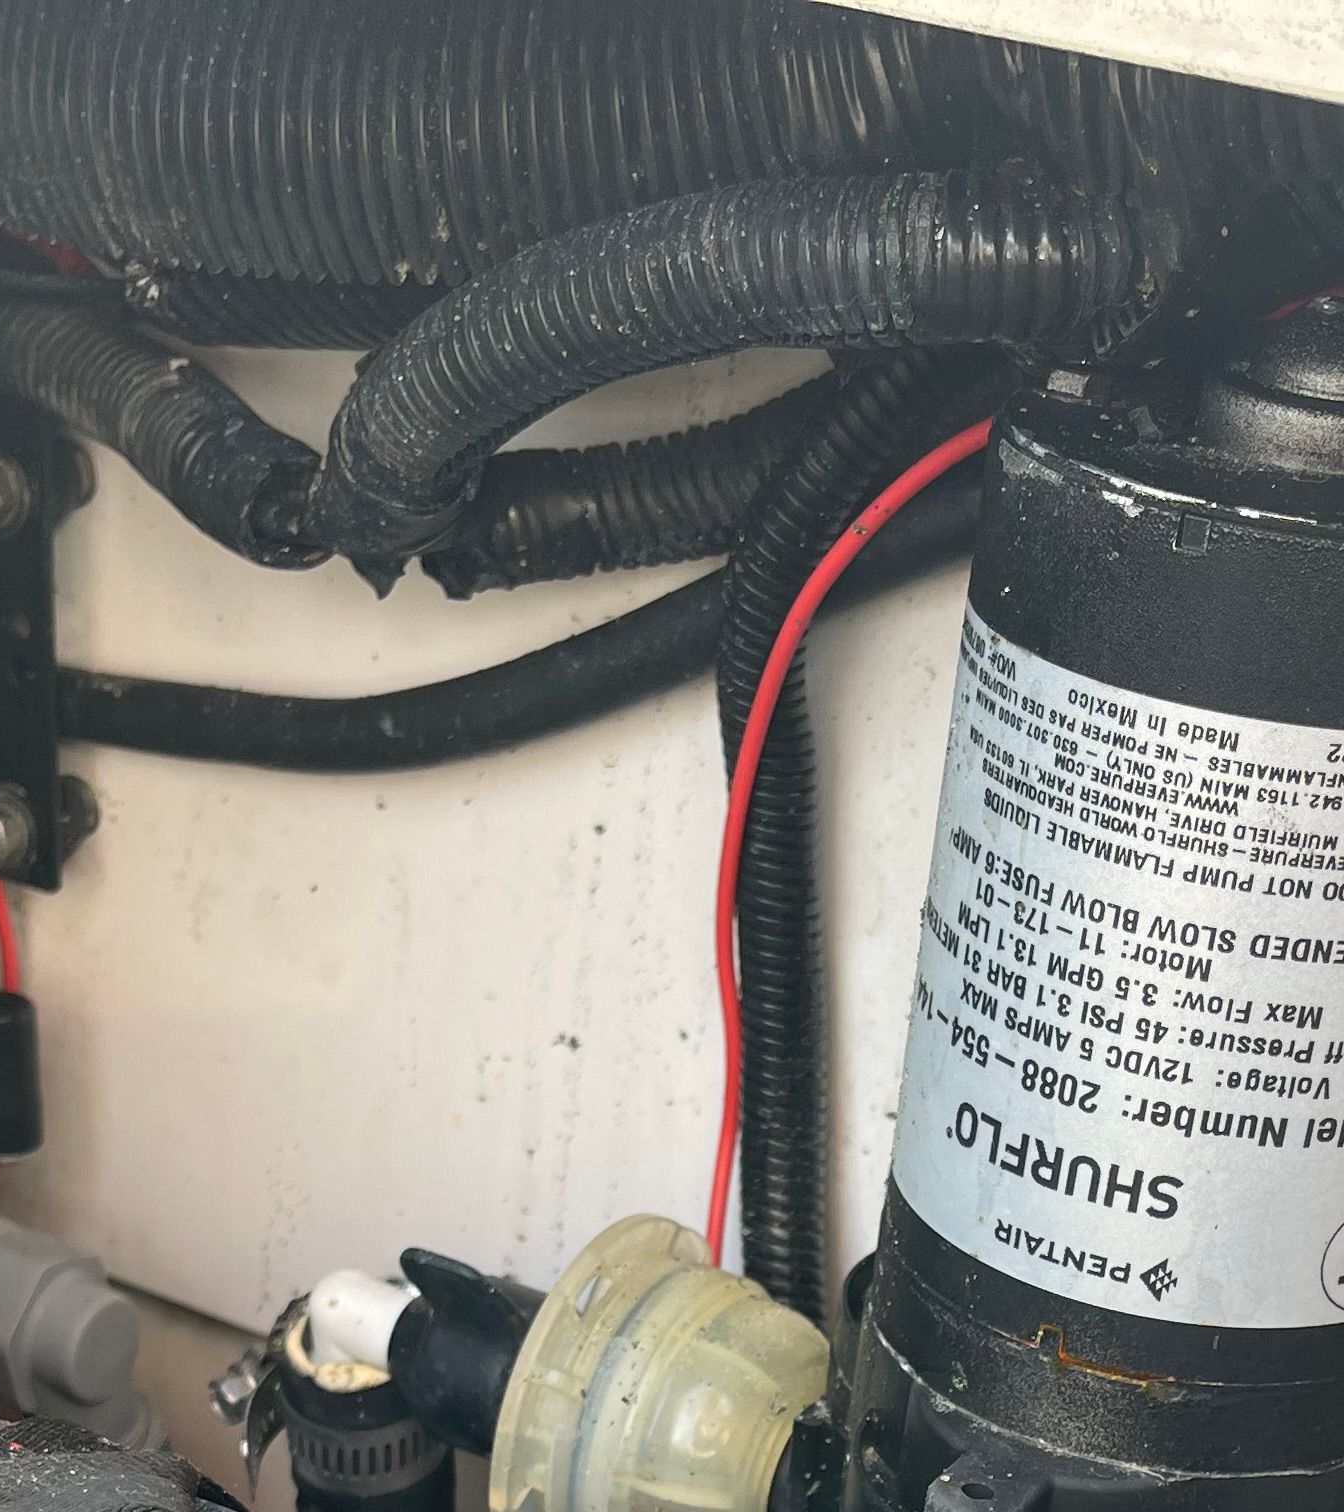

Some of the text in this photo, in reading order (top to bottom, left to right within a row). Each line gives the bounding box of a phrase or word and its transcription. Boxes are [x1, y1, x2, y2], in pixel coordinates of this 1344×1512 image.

[975, 688, 996, 715] MAIN
[1020, 696, 1045, 720] DES
[998, 706, 1079, 756] 630.307.3000
[1049, 709, 1076, 733] PAS
[1068, 689, 1239, 752] Made In Mexico
[1081, 722, 1148, 755] POMPER
[1155, 743, 1178, 763] NE
[1018, 759, 1030, 777] IL
[1034, 765, 1075, 796] PARK,
[1105, 751, 1156, 782] ONLY)
[1162, 769, 1193, 790] (US
[982, 758, 1073, 820] HEADQUARTERS
[1054, 753, 1238, 817] WWW.EVERPURE.COM
[1199, 777, 1250, 799] MAIN
[983, 787, 1039, 834] LIQUIDS
[1079, 787, 1157, 821] HANOVER
[1079, 808, 1137, 837] WORLD
[1165, 809, 1226, 837] DRIVE,
[1233, 824, 1337, 850] MUIRFIELD
[950, 826, 981, 864] AMP
[1046, 822, 1174, 879] FLAMMABLE
[1183, 865, 1254, 893] PUMP
[1262, 876, 1313, 899] NOT
[1061, 890, 1140, 934] BLOW
[1148, 916, 1236, 954] SLOW
[958, 901, 1323, 1030] Max Flow: 3.5 GPM 13.1 LPM
[964, 944, 982, 974] 31
[1121, 940, 1213, 983] Motor:
[988, 959, 1027, 1000] BAR
[1036, 984, 1072, 1018] 3.1
[1081, 1001, 1125, 1035] PSI
[960, 978, 1330, 1099] Voltage: 12VDC 5 AMPS MAX
[1135, 1017, 1168, 1044] 45
[1177, 1026, 1315, 1064] Pressure:
[1121, 1095, 1288, 1148] Number:
[955, 1102, 1184, 1219] SHURFLO
[994, 1219, 1131, 1284] PENTAIR
